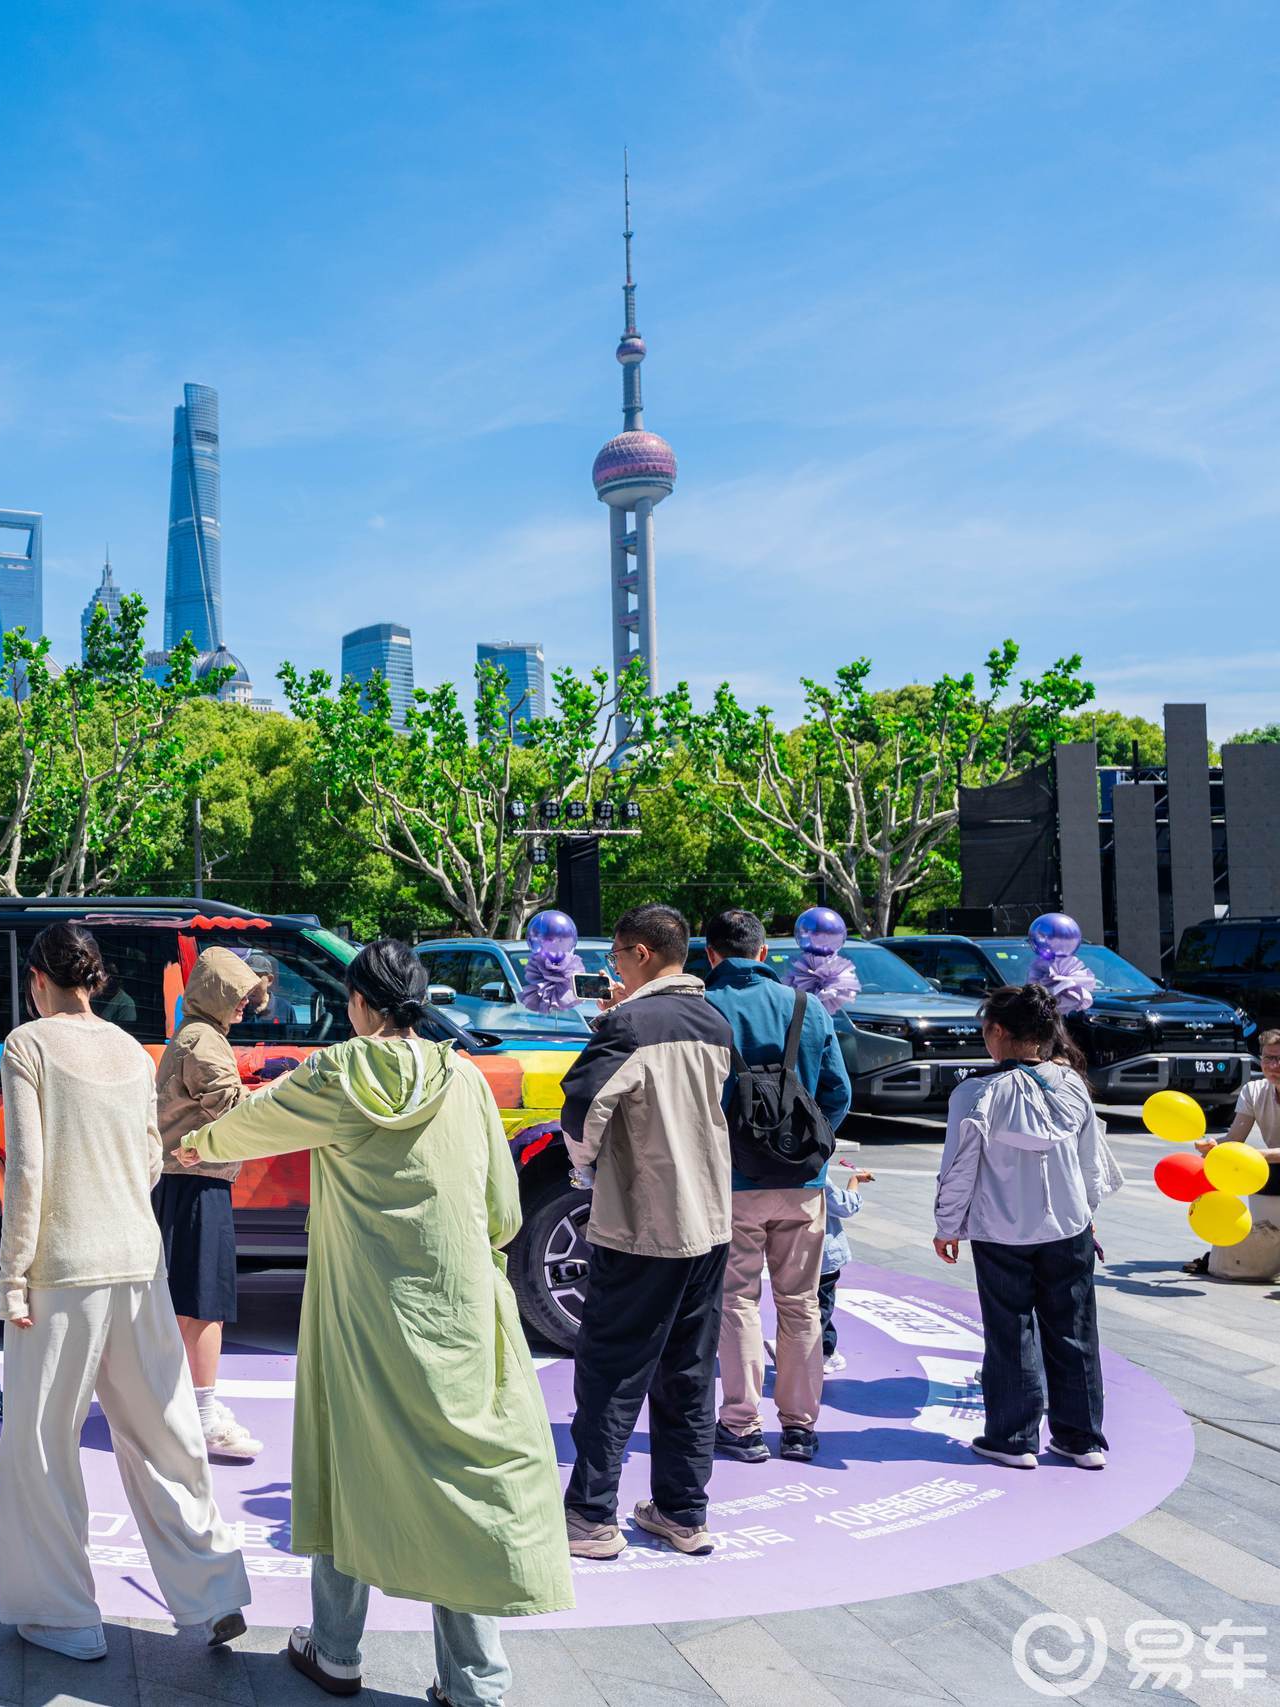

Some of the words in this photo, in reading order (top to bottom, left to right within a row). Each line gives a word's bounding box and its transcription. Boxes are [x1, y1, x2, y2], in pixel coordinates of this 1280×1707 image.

[1195, 1060, 1215, 1073] 钛3
[767, 1481, 839, 1505] 5%
[814, 1477, 979, 1530] 10倍新国标
